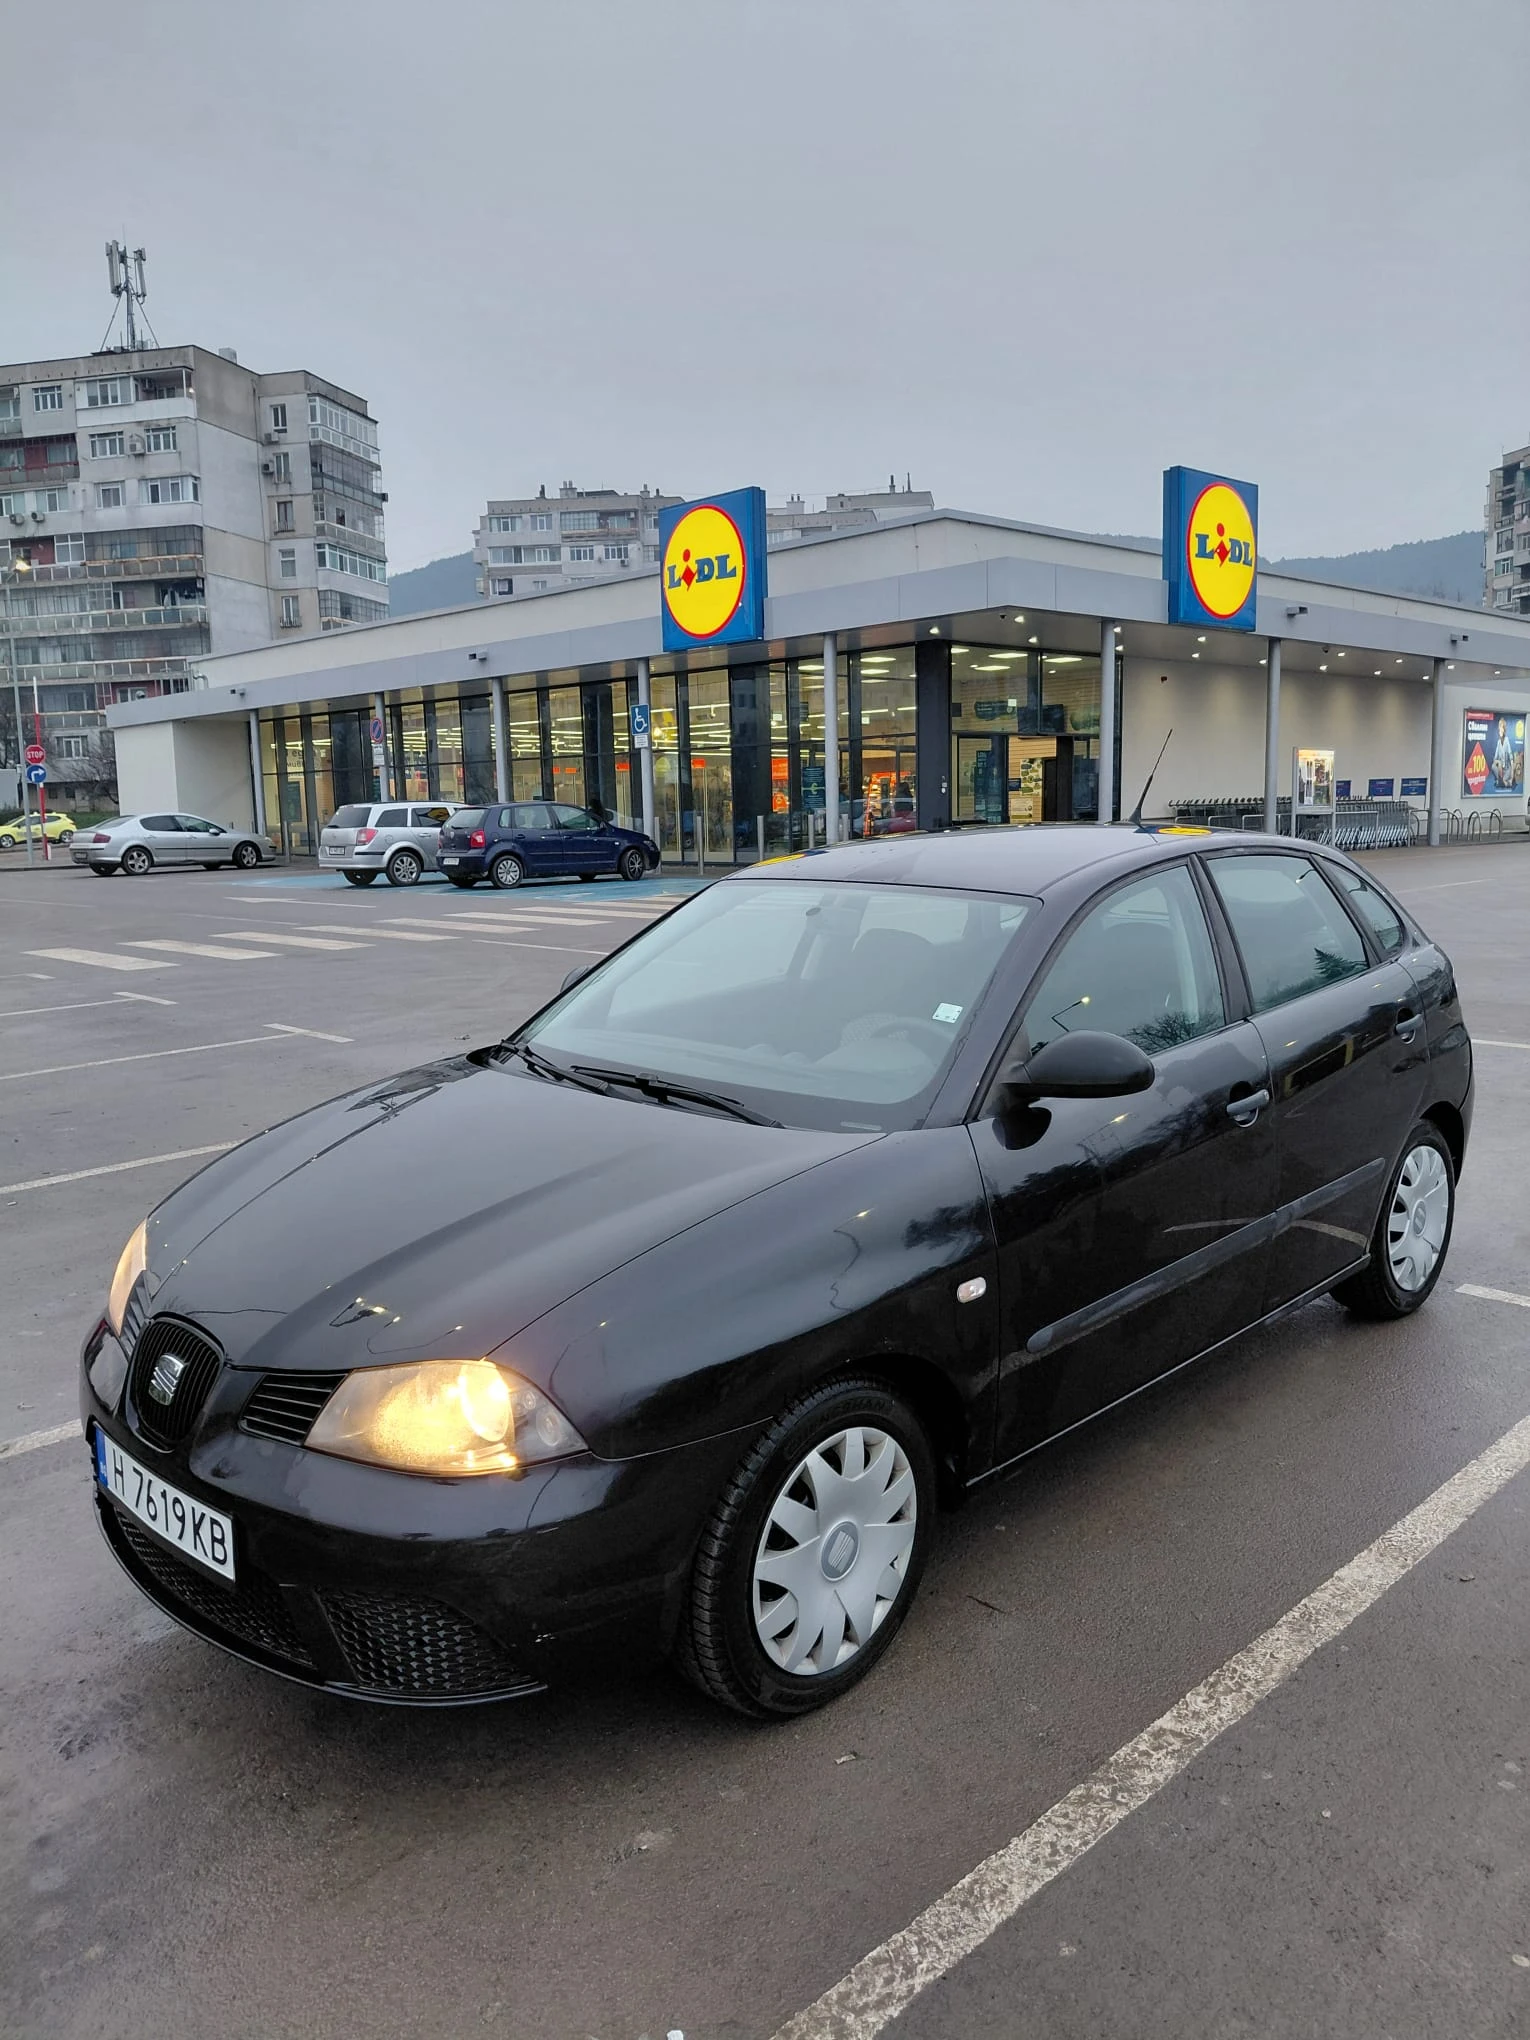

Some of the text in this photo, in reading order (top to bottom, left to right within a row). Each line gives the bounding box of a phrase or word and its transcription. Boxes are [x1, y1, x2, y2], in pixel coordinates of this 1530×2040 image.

[1195, 523, 1253, 568] LIDL
[667, 548, 737, 592] LIDL
[26, 751, 44, 759] STOP
[1473, 755, 1486, 773] 100
